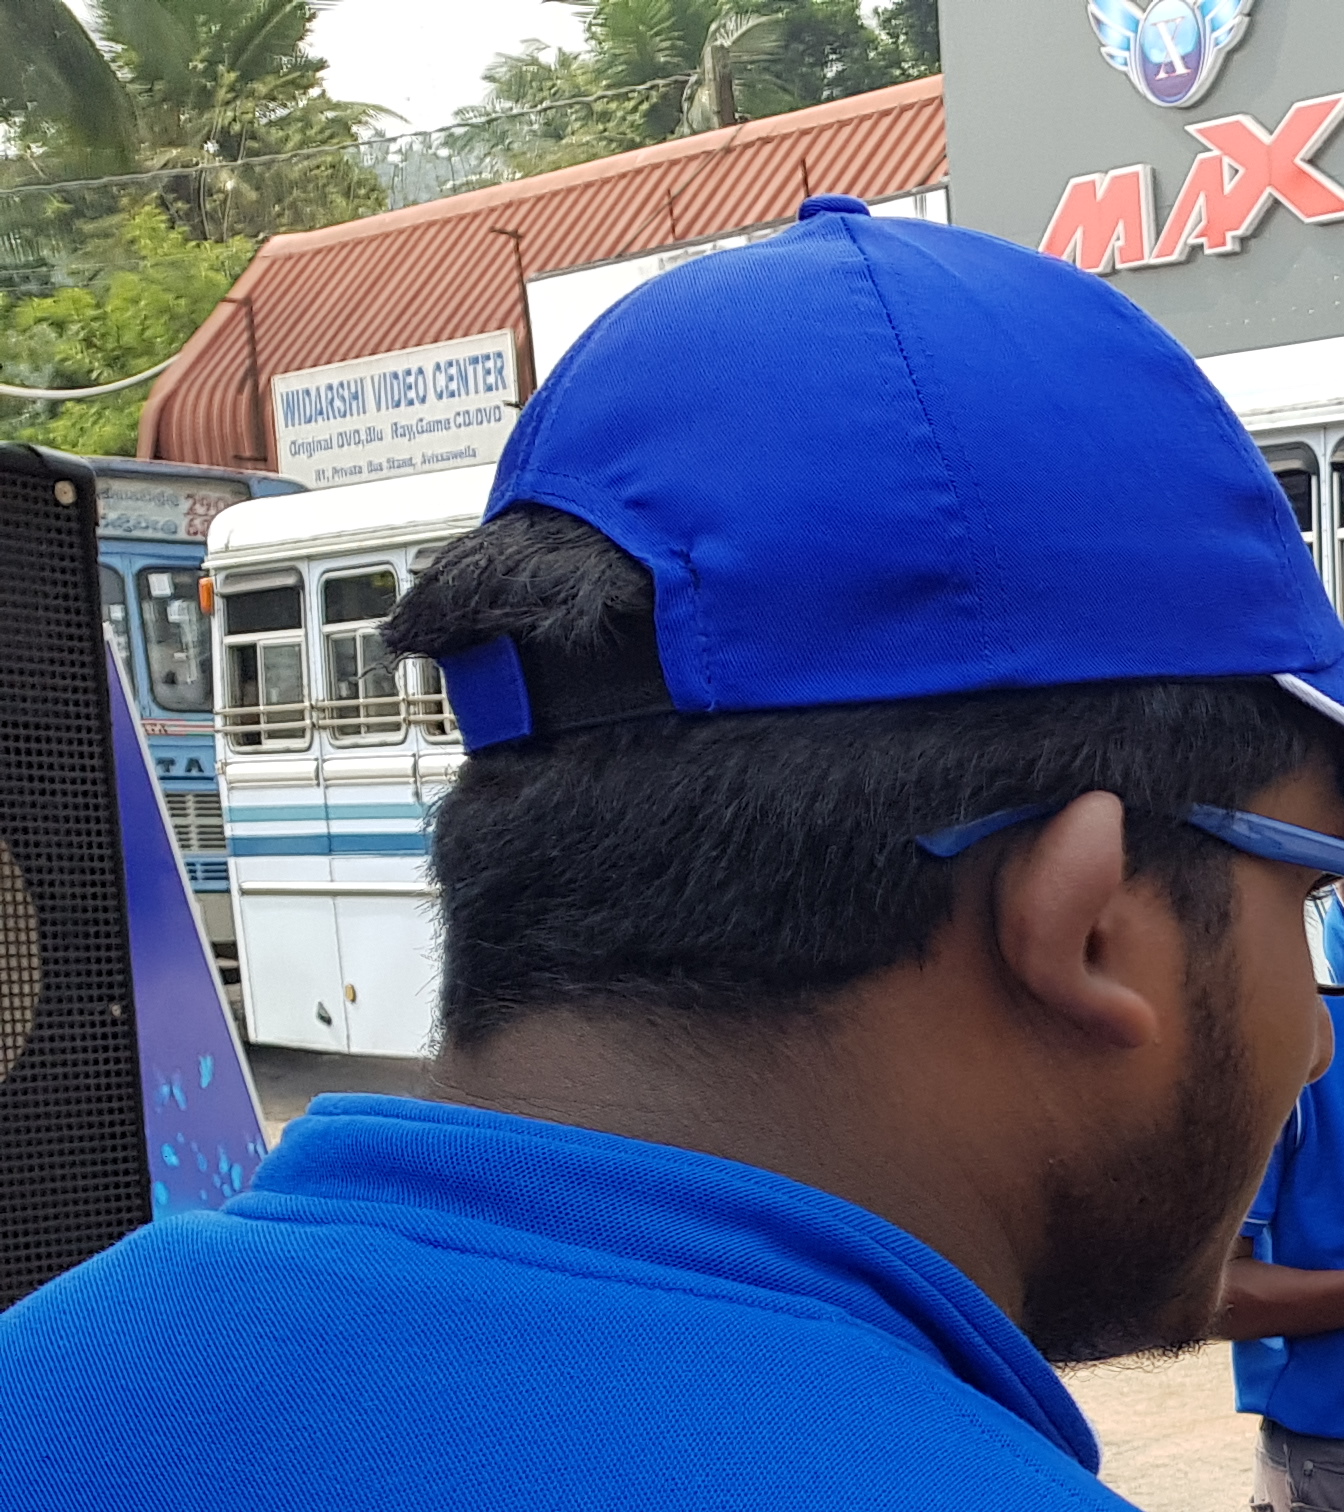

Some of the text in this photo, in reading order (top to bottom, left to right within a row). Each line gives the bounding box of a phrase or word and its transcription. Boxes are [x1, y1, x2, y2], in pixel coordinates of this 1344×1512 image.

[280, 350, 508, 429] WIDARSHI VIDEO CENTER
[289, 435, 333, 459] Original
[453, 405, 502, 430] CD/DVD
